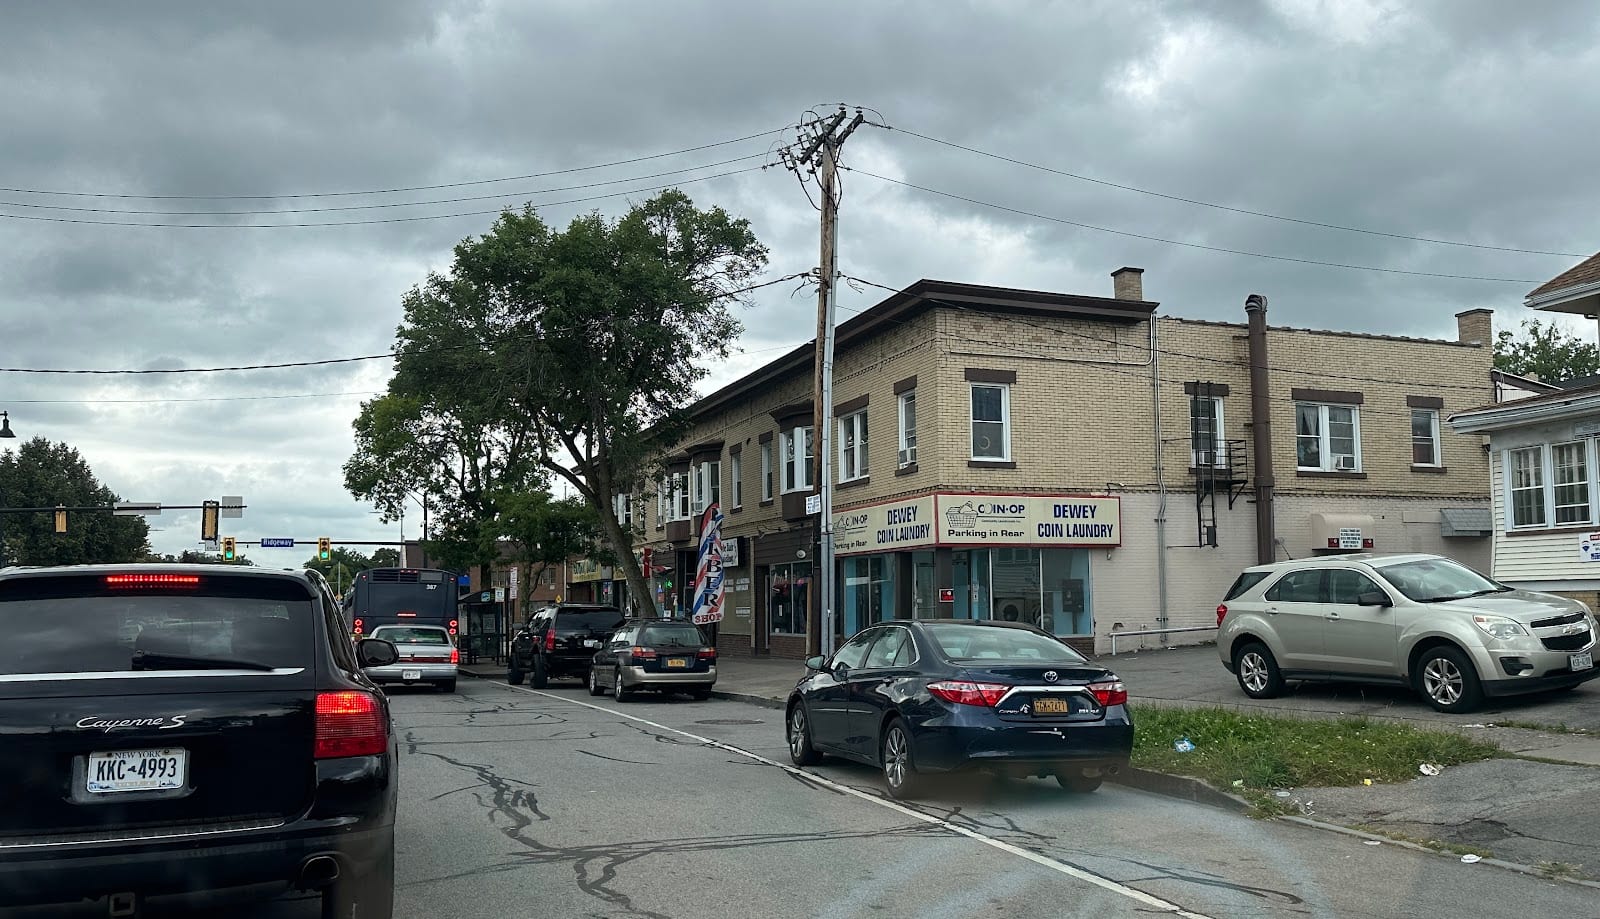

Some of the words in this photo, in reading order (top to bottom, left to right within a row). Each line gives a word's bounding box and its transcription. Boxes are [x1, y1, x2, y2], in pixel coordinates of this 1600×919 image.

[887, 505, 918, 525] DEWEY
[1053, 504, 1097, 518] DEWEY
[877, 529, 894, 544] COIN
[895, 524, 930, 542] LAUNDRY
[947, 529, 987, 538] Parking
[989, 529, 998, 537] in
[1001, 529, 1025, 537] Rear
[1038, 523, 1063, 538] COIN
[1066, 523, 1113, 538] LAUNDRY
[262, 538, 293, 547] Ridgeway
[694, 612, 722, 624] SHOP
[76, 716, 164, 733] Cayenne
[159, 715, 187, 729] S
[115, 751, 136, 759] NEW
[138, 750, 162, 759] YORK
